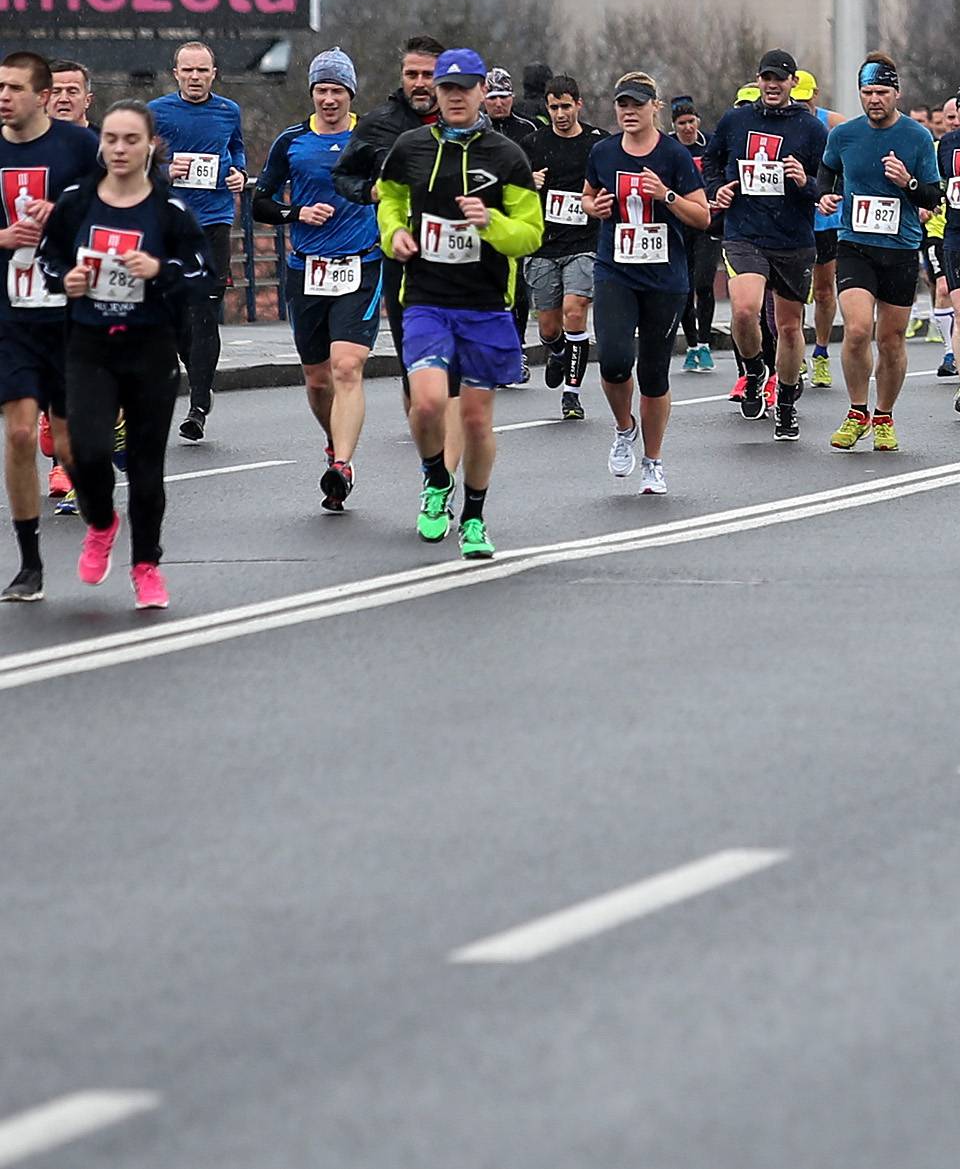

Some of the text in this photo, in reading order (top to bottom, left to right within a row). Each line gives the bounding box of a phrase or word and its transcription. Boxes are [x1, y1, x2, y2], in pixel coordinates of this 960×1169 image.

[196, 165, 214, 178] 651
[760, 173, 779, 185] 876
[567, 203, 584, 215] 44
[875, 209, 895, 222] 827
[448, 235, 473, 250] 504
[641, 237, 662, 250] 818
[108, 270, 135, 288] 282
[332, 270, 354, 283] 806
